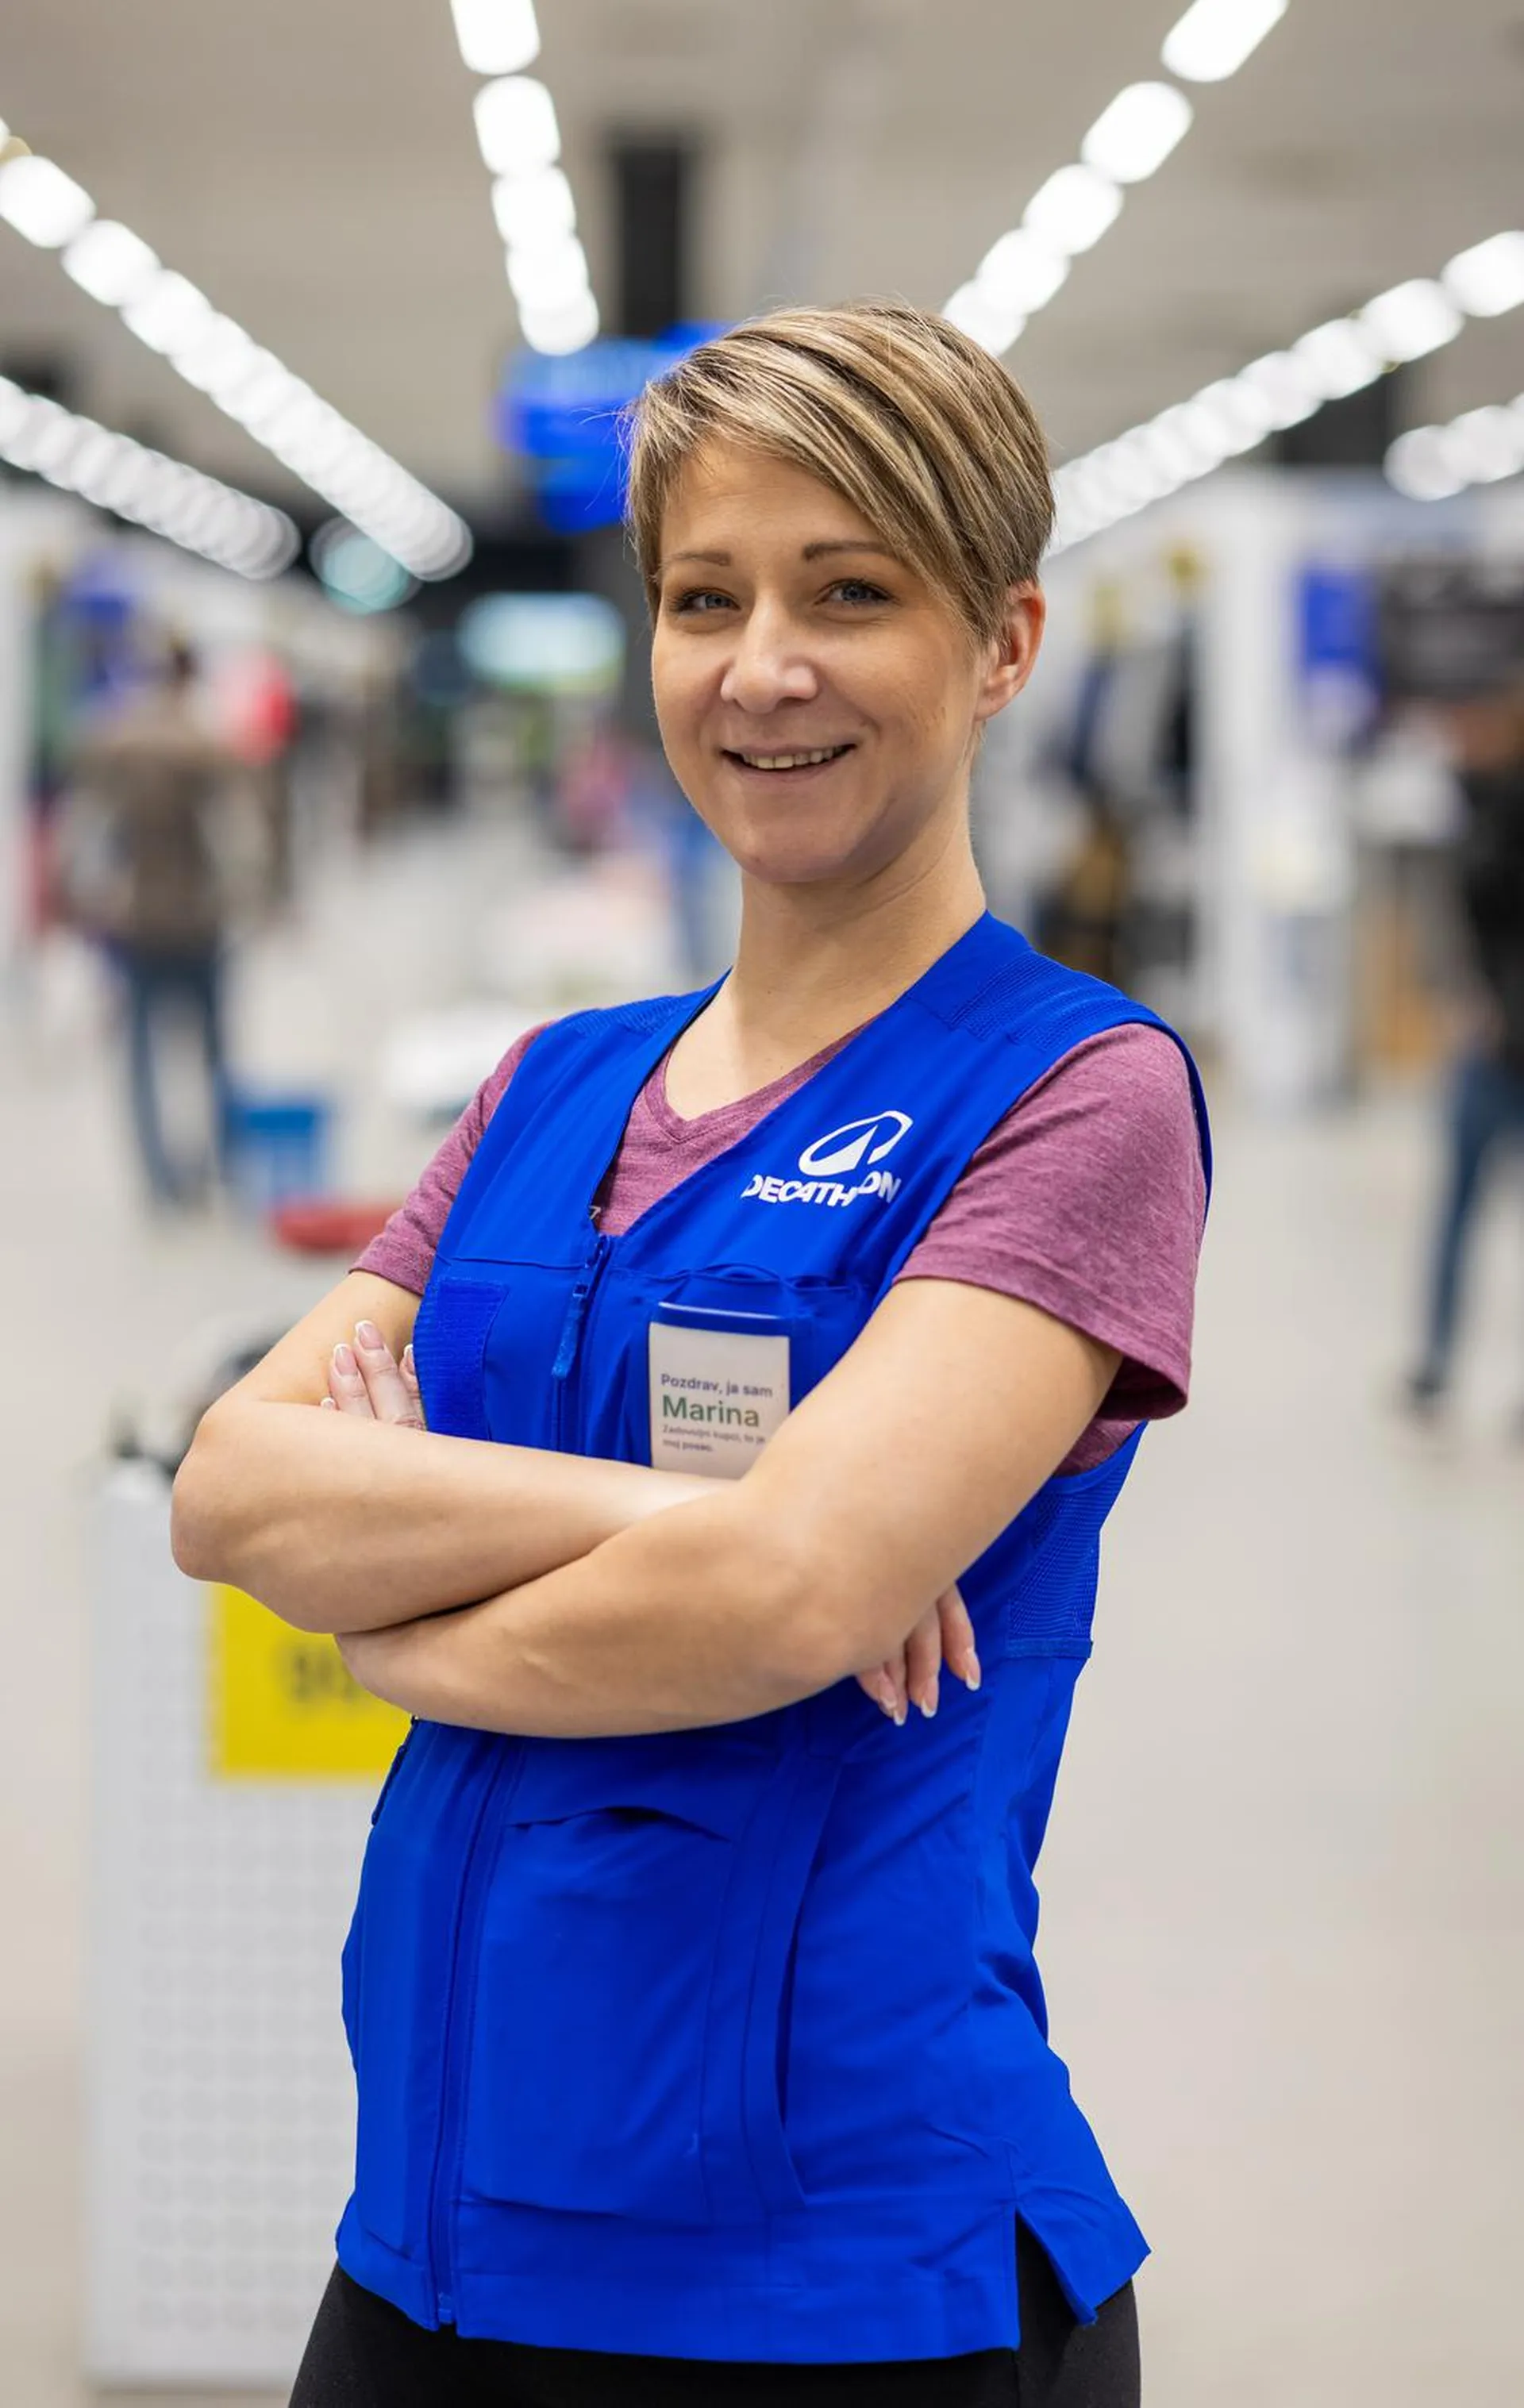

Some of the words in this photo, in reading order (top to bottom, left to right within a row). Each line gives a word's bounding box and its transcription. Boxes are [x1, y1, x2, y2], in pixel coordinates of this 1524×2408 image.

[741, 1170, 902, 1207] DECATHON
[660, 1373, 723, 1394] Pozdrav,
[725, 1379, 739, 1397] ja
[743, 1383, 773, 1398] sam
[662, 1394, 760, 1427] Marina
